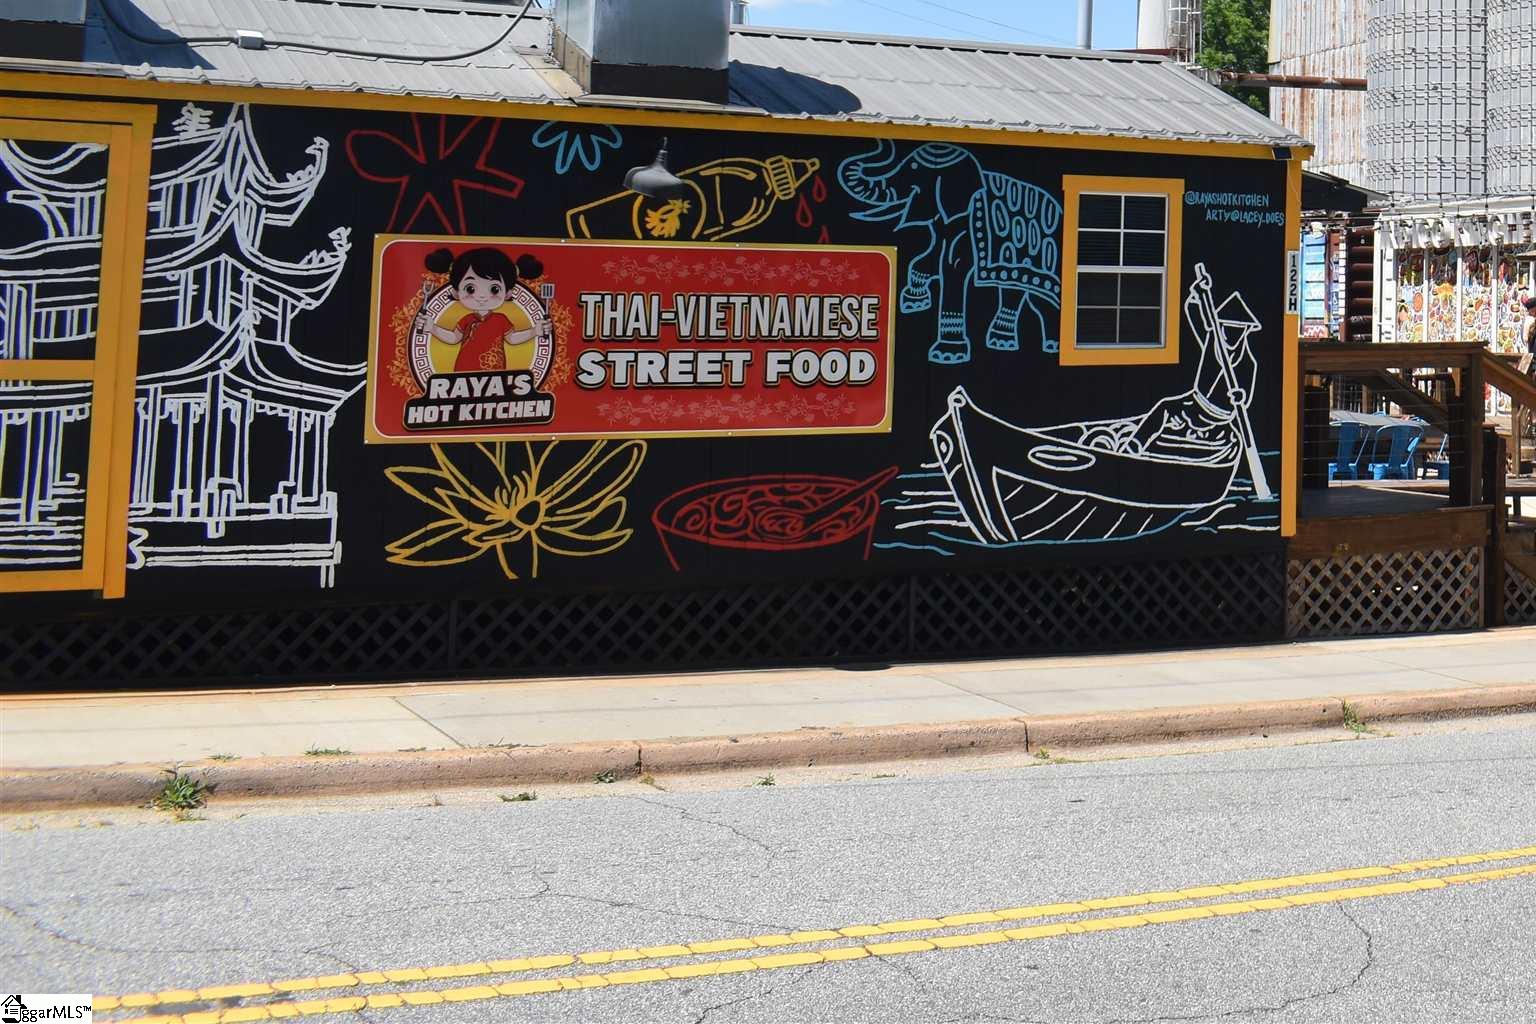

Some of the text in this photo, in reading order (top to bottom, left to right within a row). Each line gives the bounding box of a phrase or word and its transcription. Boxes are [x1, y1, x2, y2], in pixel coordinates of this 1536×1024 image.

[1289, 255, 1297, 312] 122H
[580, 293, 881, 340] THAI-VIETNAMESE
[428, 374, 533, 400] RAYA'S
[575, 350, 877, 387] STREET FOOD
[407, 399, 551, 425] HOT KITCHEN
